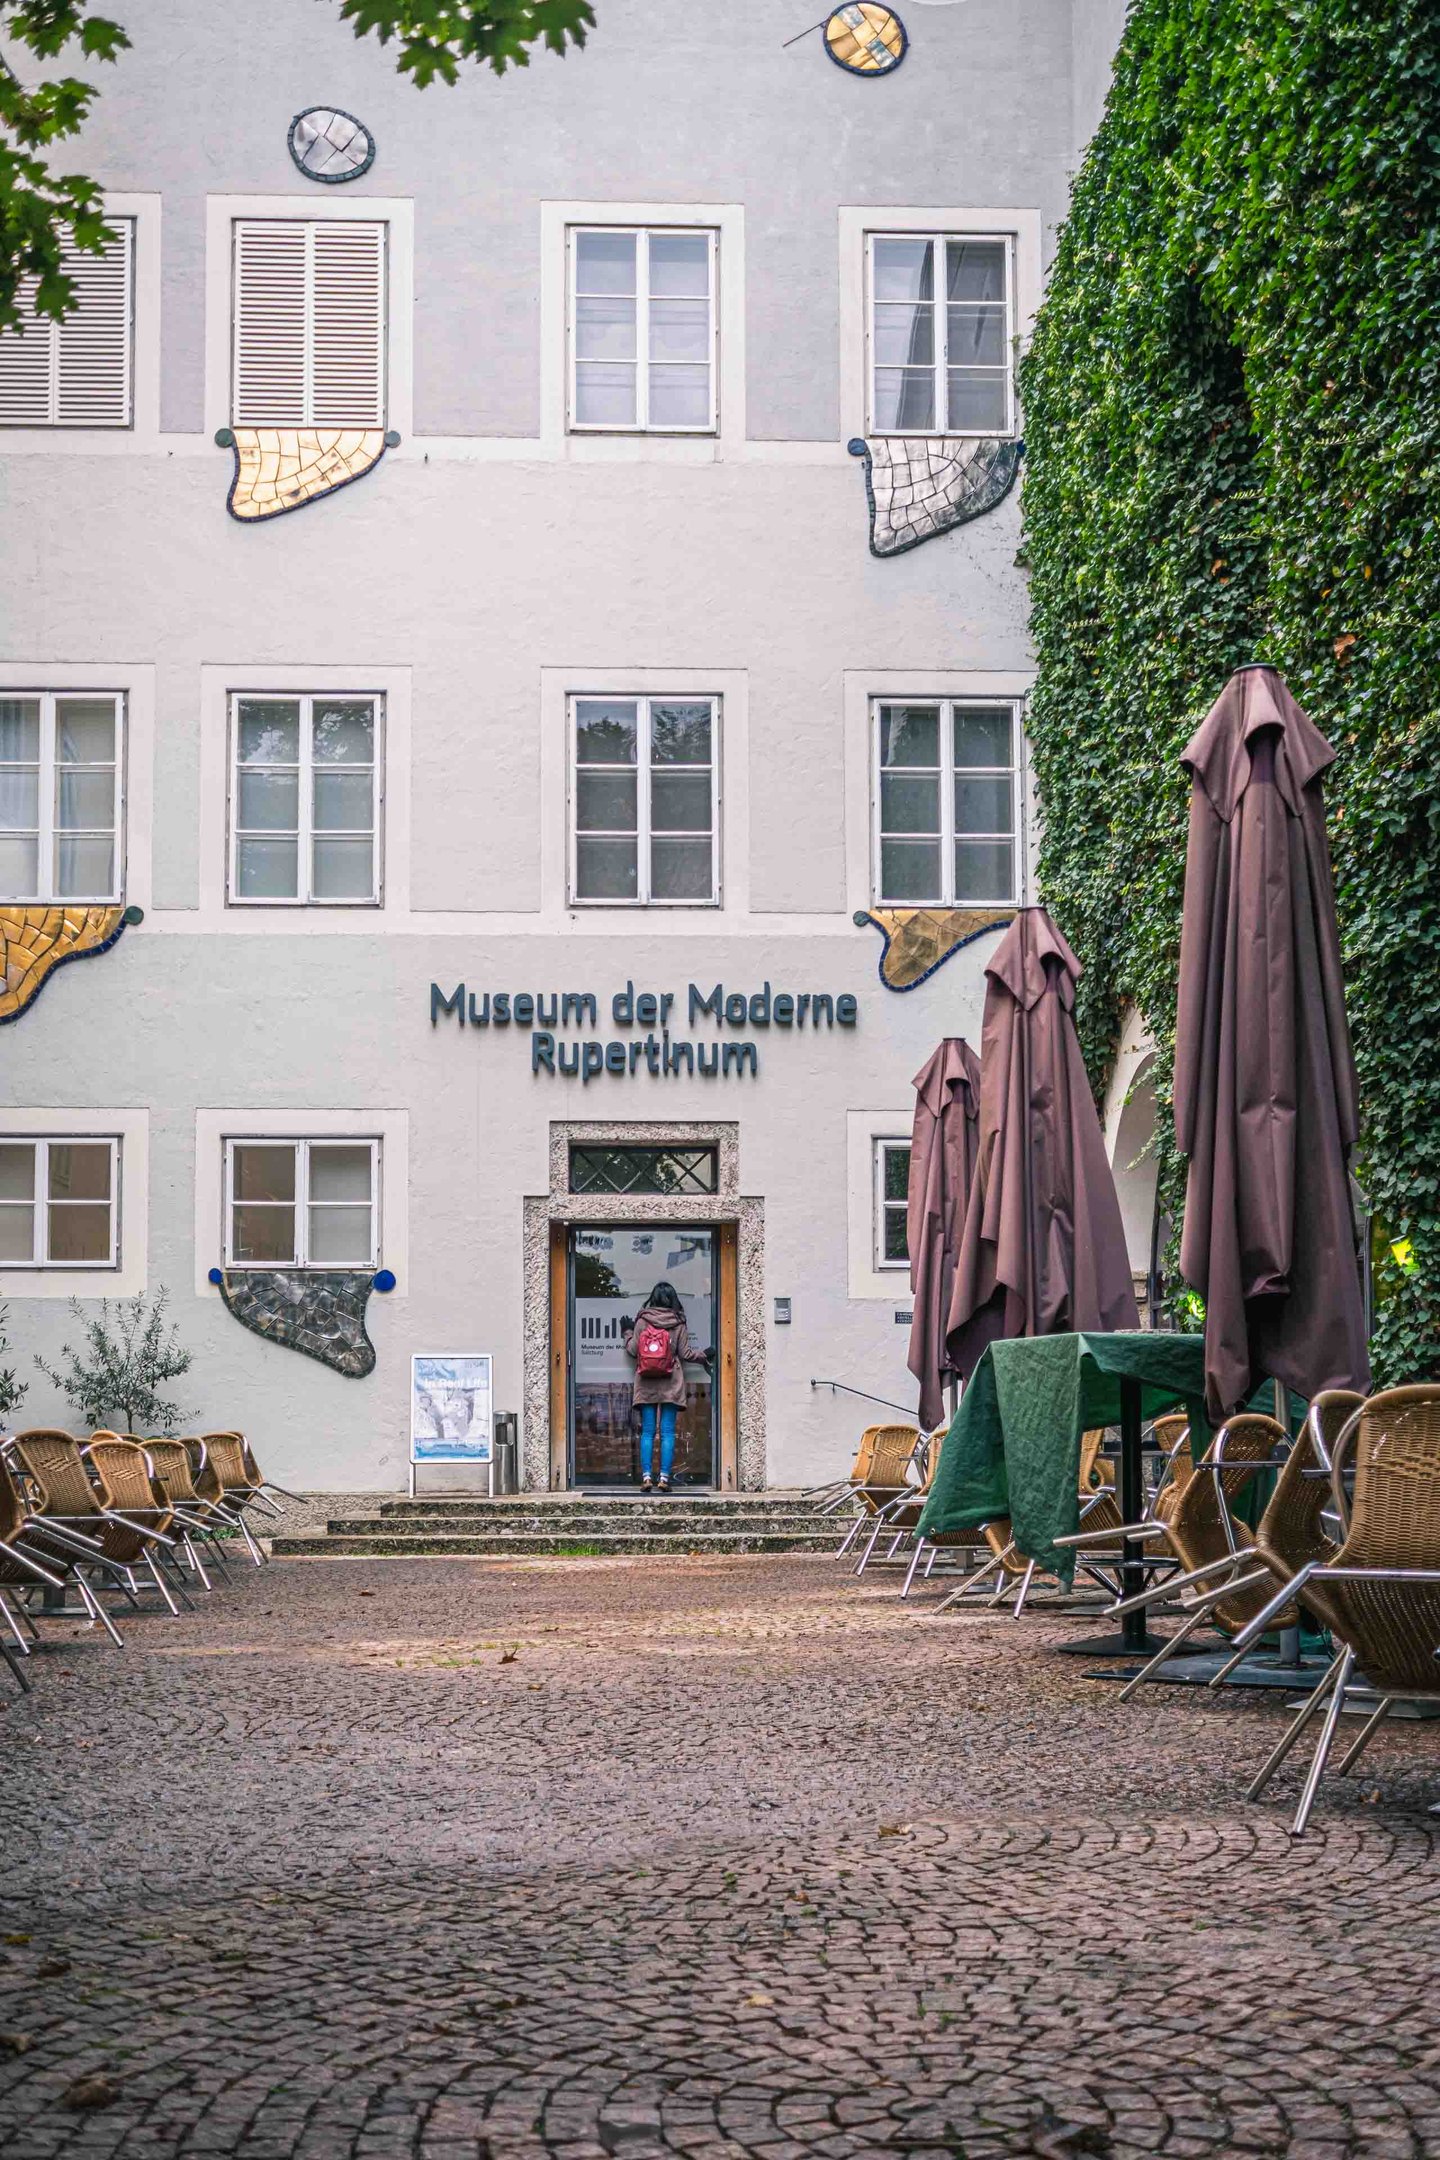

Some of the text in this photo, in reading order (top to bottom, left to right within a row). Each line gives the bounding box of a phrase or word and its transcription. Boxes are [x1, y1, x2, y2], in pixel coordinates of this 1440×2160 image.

[430, 980, 858, 1026] Museum der Moderne
[532, 1030, 758, 1083] Rupertinum
